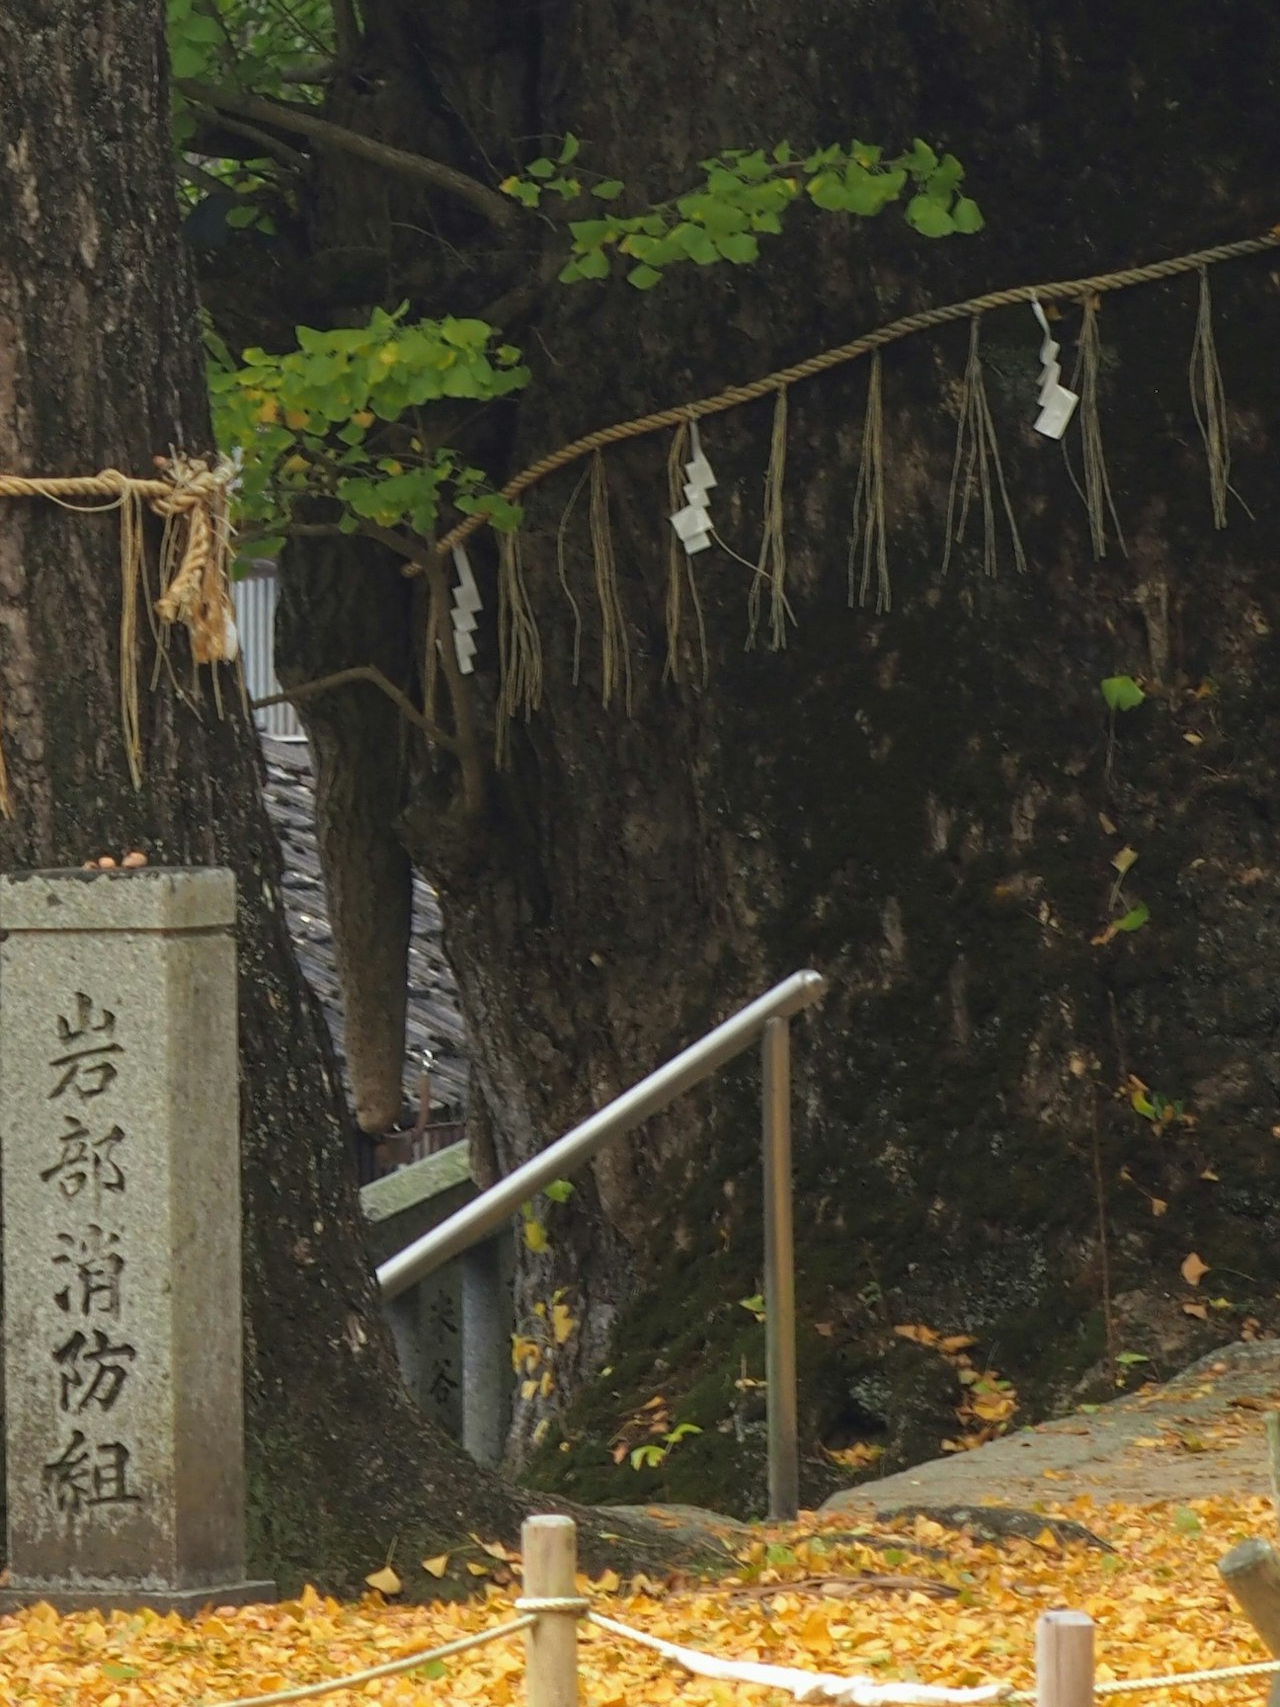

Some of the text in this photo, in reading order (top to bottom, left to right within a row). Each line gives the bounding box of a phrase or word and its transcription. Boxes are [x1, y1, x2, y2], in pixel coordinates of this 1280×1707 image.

[40, 992, 143, 1514] 岩部消防組
